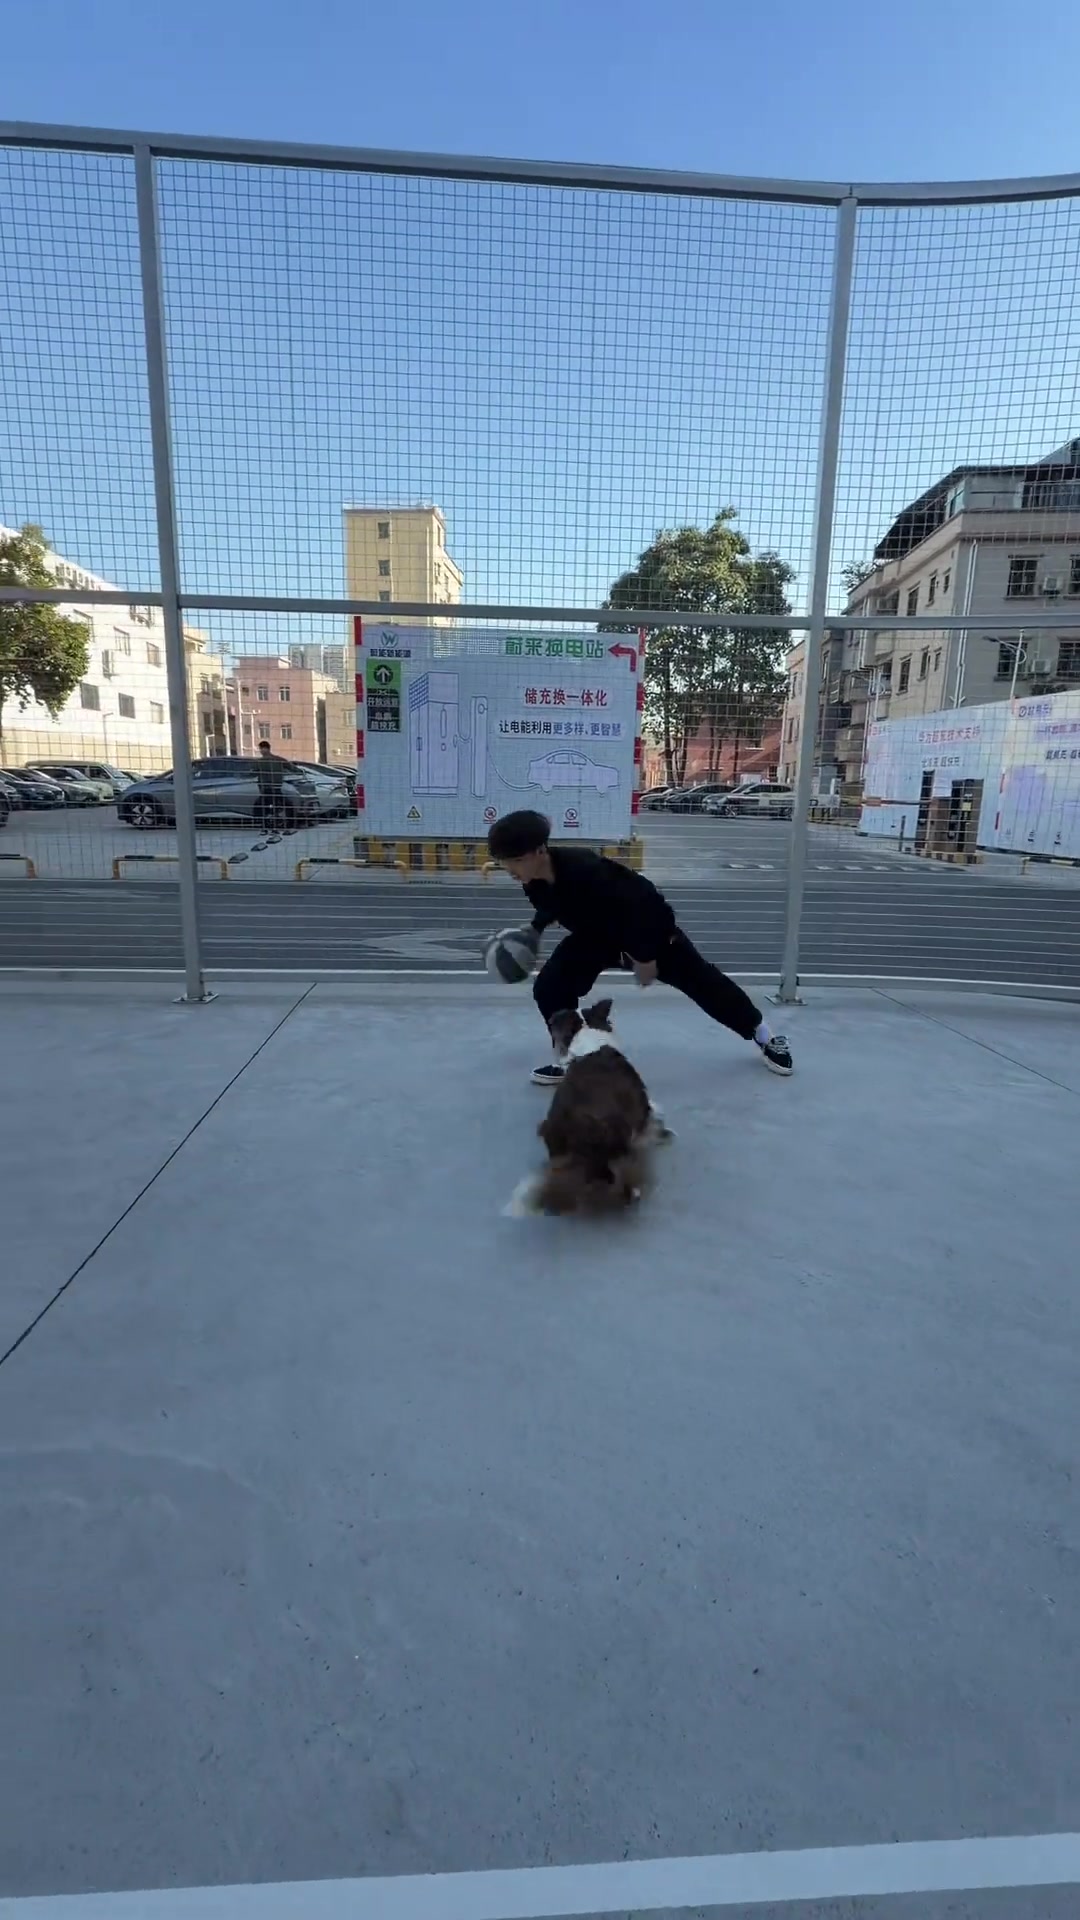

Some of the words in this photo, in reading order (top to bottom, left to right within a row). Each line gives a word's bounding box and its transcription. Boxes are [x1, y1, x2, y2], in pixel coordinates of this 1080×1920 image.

[505, 636, 604, 658] 蔚来换电站
[524, 687, 608, 707] 储充换一体化
[499, 719, 622, 737] 让电能利用更多样、更智慧
